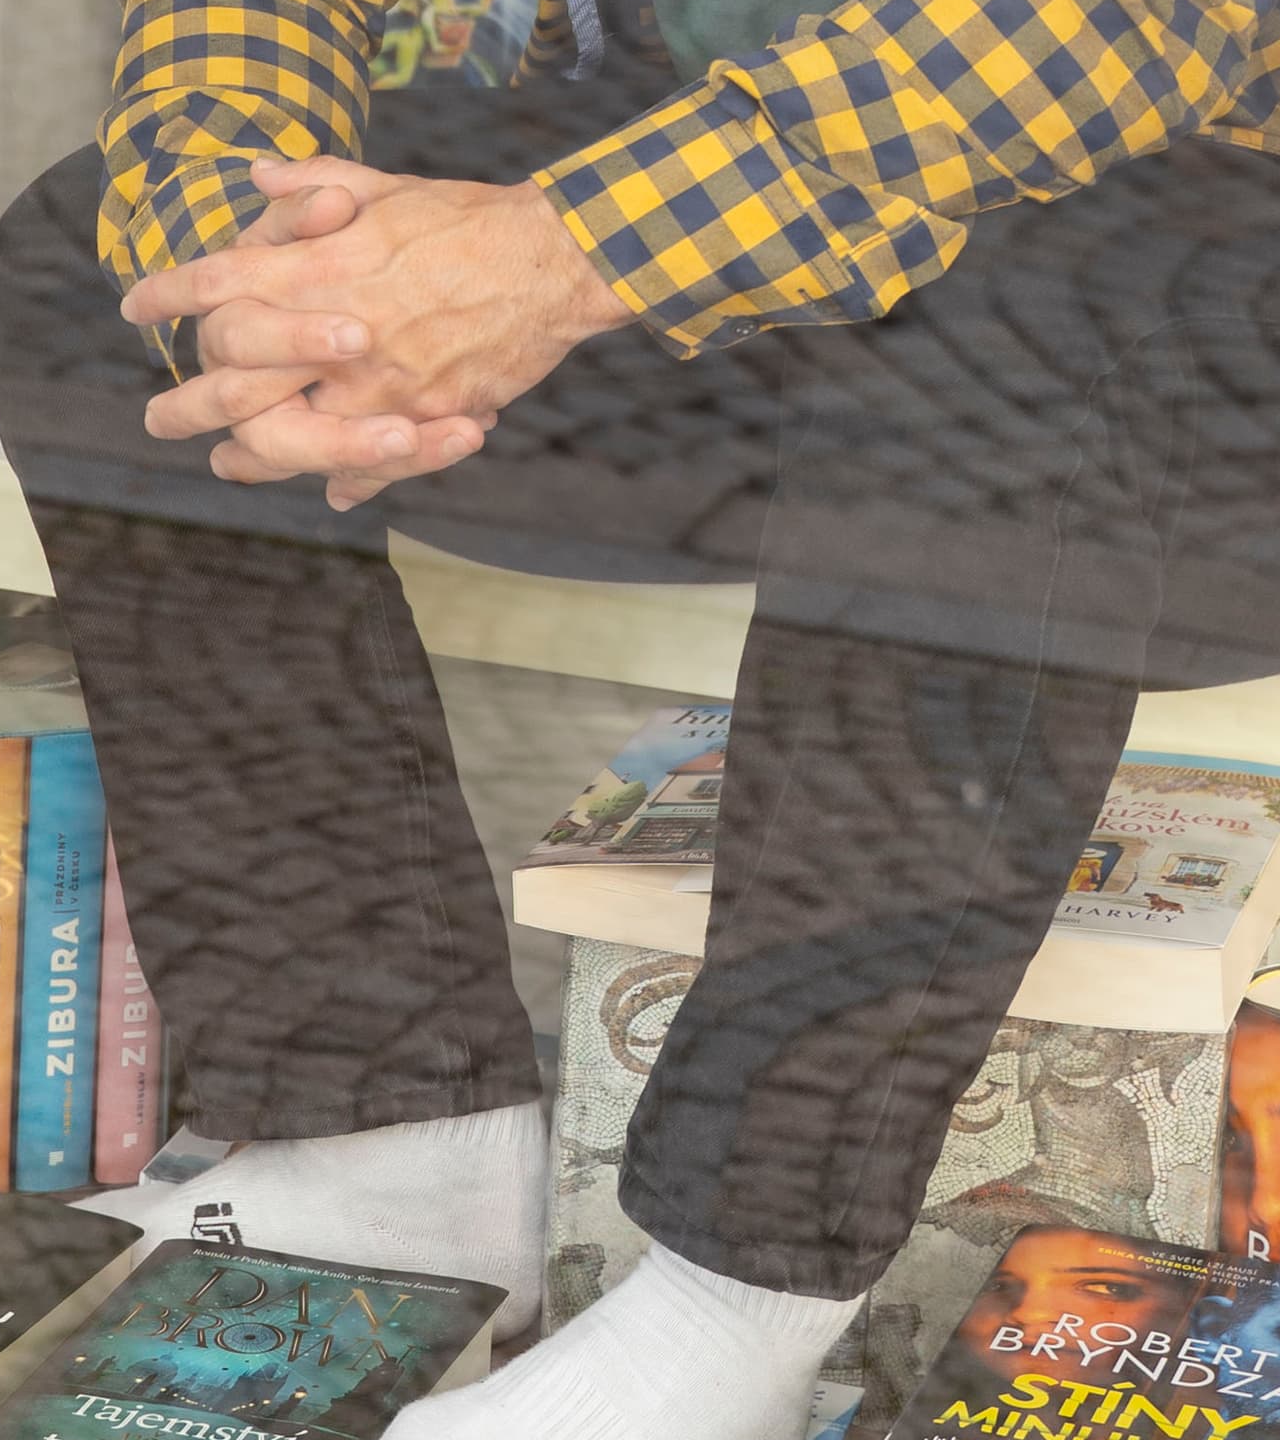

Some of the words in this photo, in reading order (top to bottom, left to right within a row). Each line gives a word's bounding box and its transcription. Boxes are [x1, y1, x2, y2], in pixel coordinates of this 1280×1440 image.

[1065, 904, 1177, 924] HARVEY
[46, 917, 80, 1078] ZIBURA
[186, 1266, 415, 1336] DAN
[116, 1302, 416, 1374] BROWN
[1053, 1313, 1279, 1374] ROBERT
